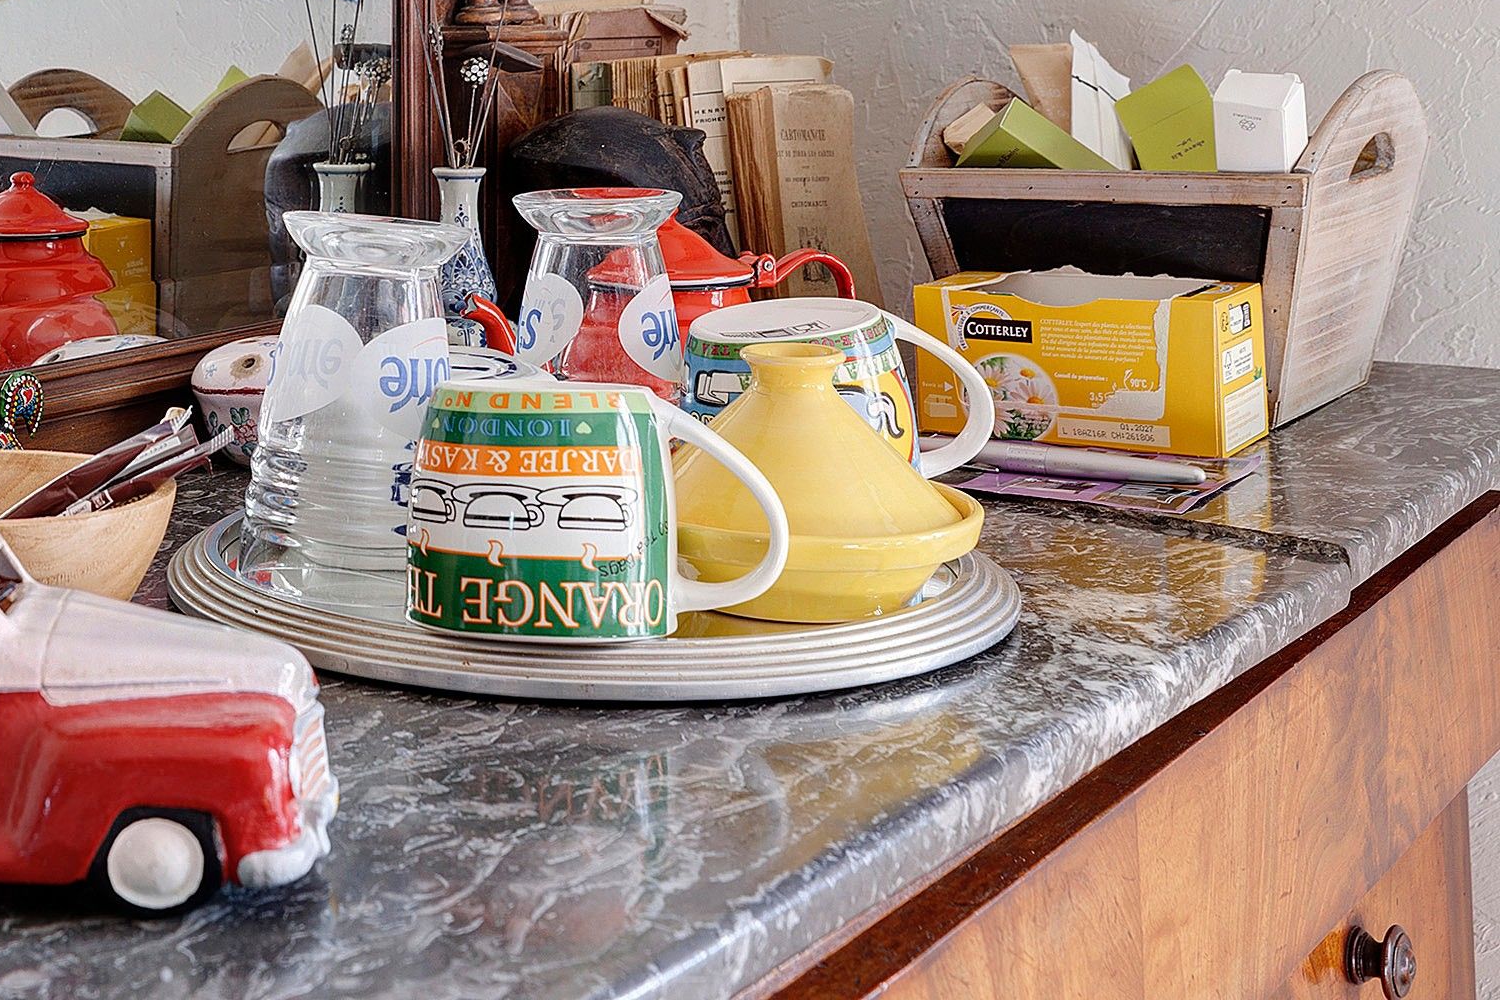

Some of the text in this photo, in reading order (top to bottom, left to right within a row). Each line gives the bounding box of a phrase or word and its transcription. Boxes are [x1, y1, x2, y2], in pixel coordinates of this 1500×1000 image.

[966, 321, 1029, 338] COTTERLEY
[489, 391, 622, 411] BLEND
[441, 416, 573, 438] LONDON
[1061, 427, 1067, 435] L
[1119, 423, 1154, 434] 01.2027
[485, 450, 512, 473] &
[519, 446, 639, 475] DARJEE
[459, 576, 664, 629] ORANGE
